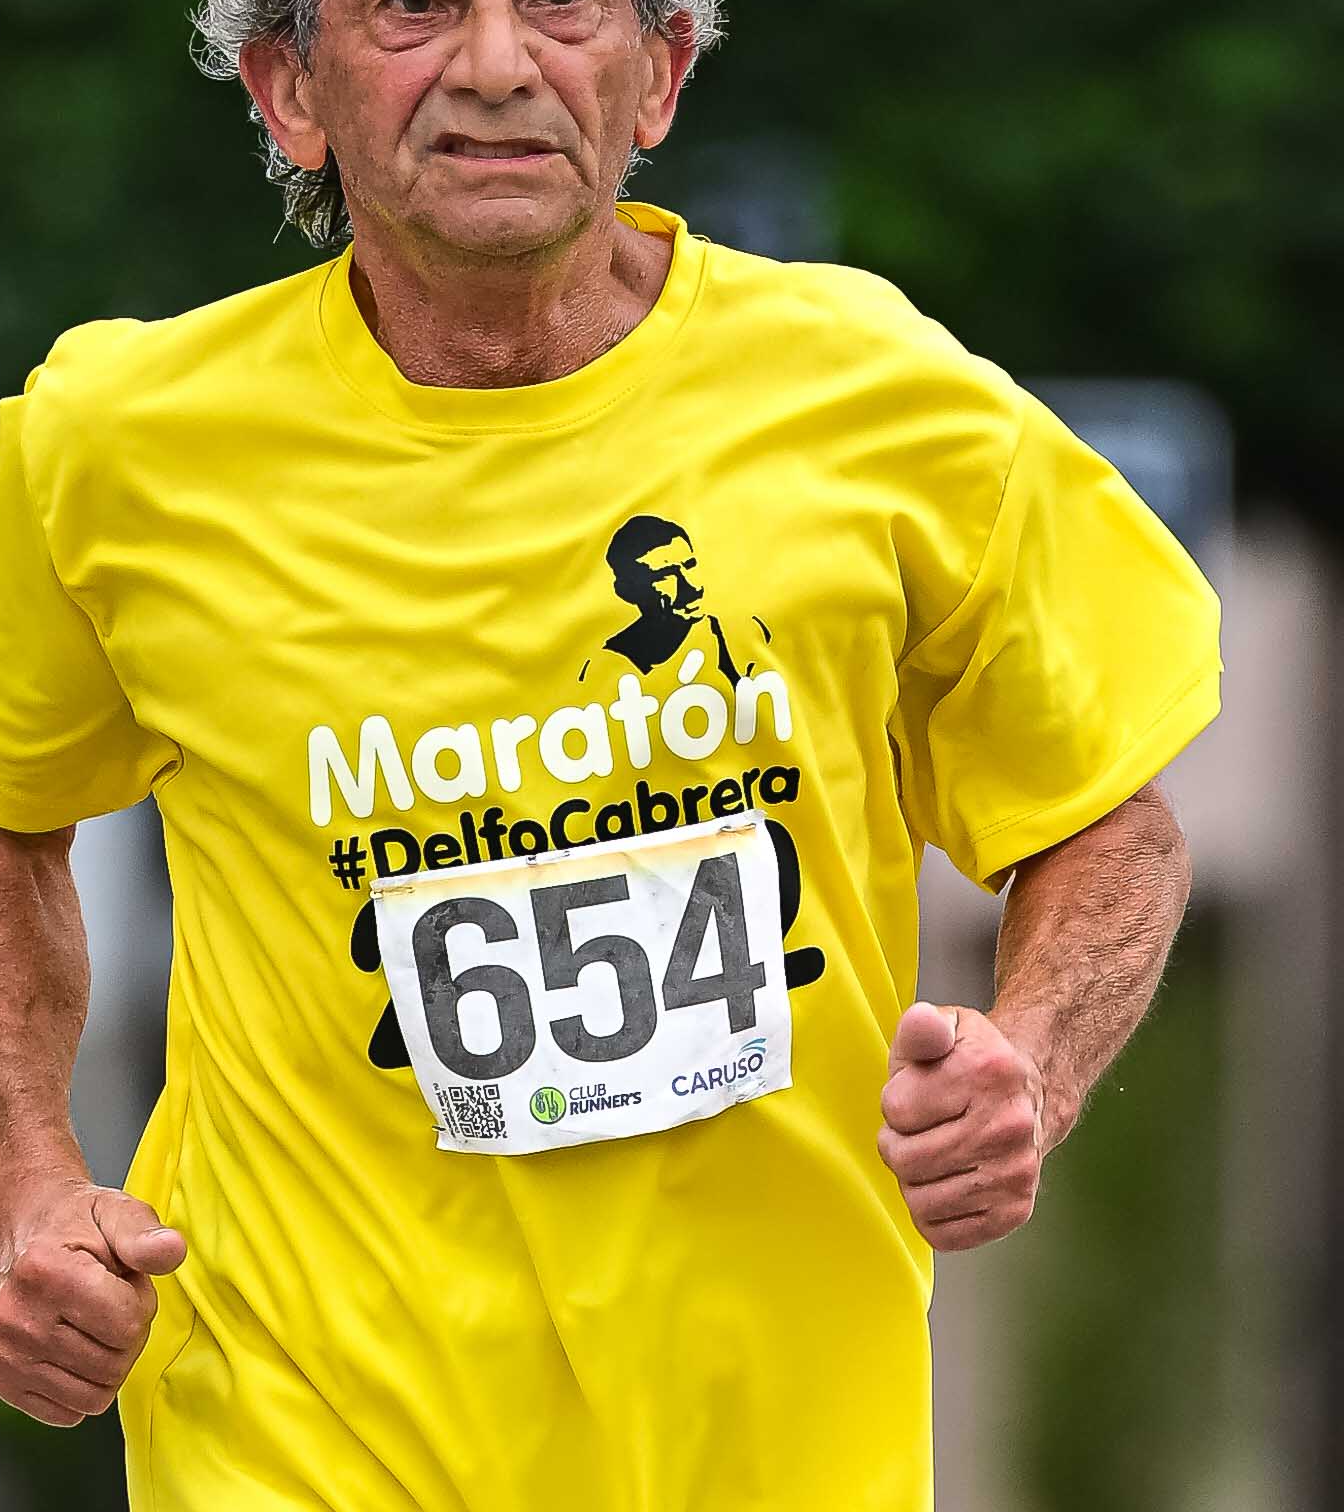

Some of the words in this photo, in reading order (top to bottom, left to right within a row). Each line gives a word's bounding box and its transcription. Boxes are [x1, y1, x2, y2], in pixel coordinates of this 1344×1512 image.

[307, 649, 793, 827] Maratón
[328, 766, 801, 890] #DelfoCabrera
[412, 852, 766, 1080] 654
[569, 1083, 606, 1100] CLUB
[569, 1091, 642, 1115] RUNNER'S
[671, 1053, 763, 1096] CARUSO
